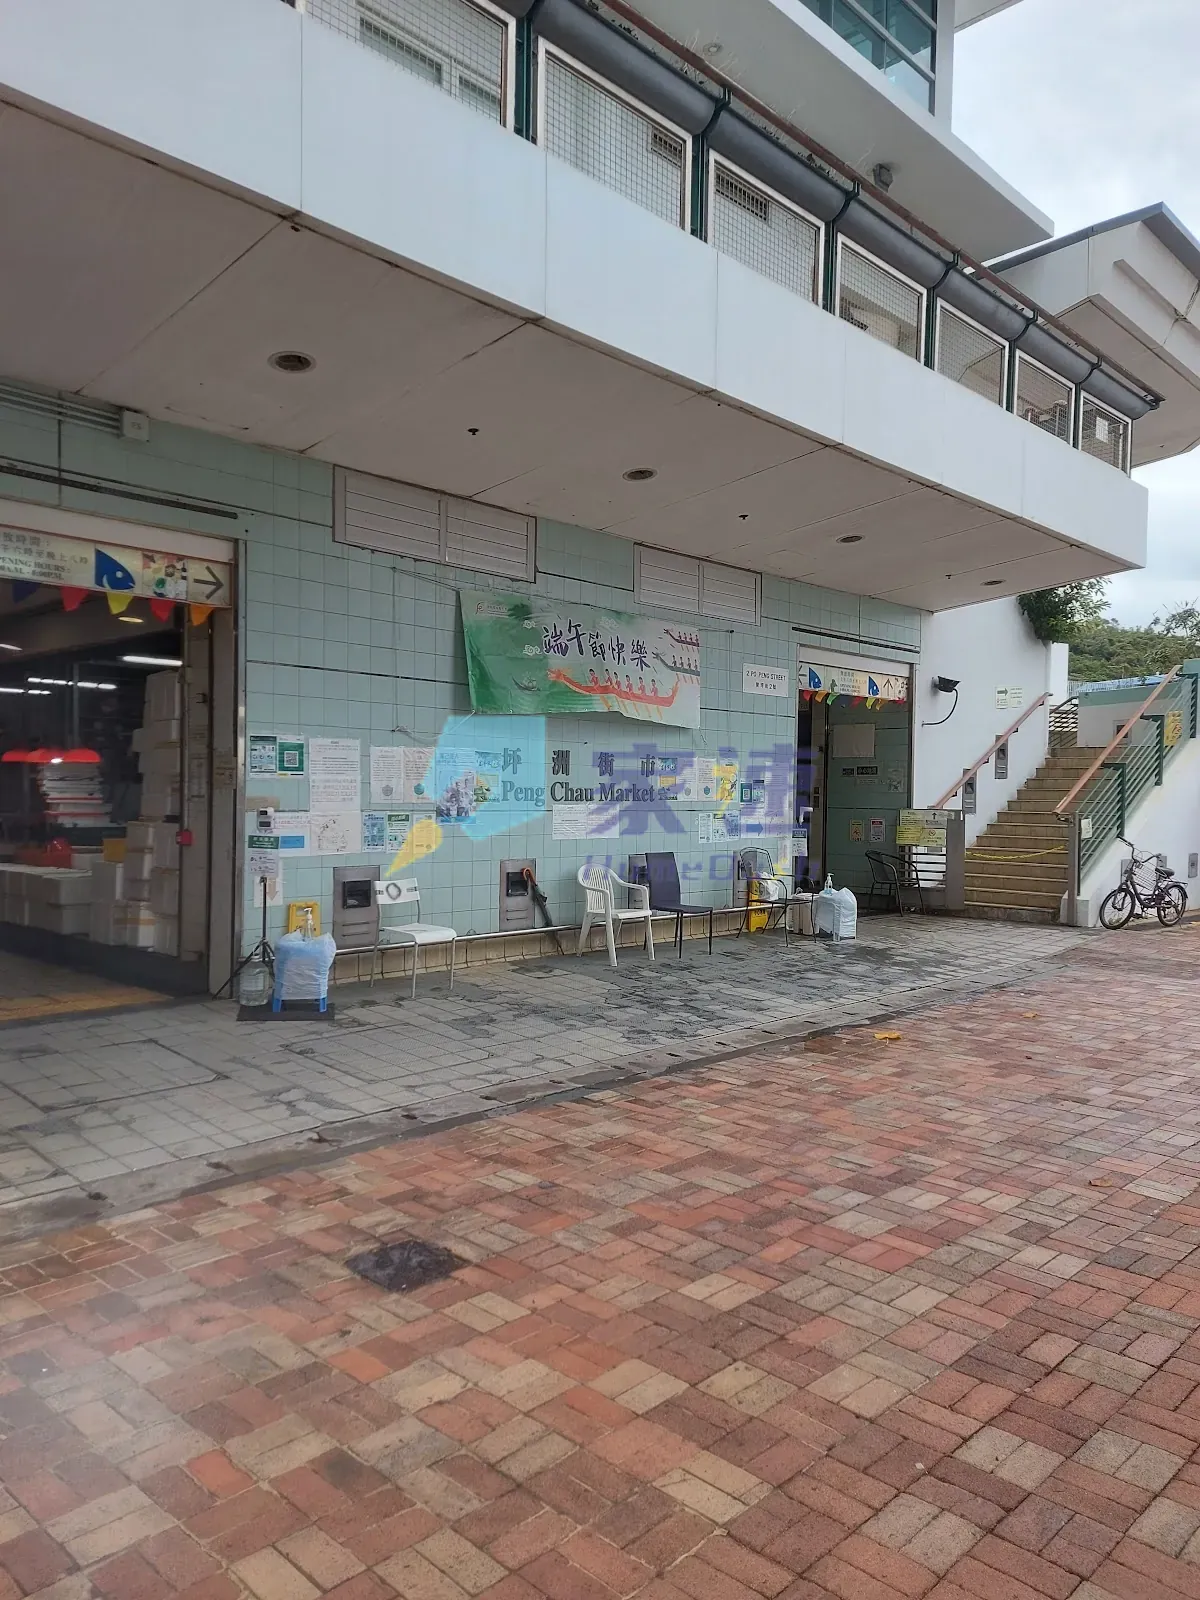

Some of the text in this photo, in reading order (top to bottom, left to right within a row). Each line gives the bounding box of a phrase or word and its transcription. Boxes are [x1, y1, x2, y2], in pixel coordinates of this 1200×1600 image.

[542, 618, 652, 672] 端午節快樂
[770, 673, 786, 681] STREET
[501, 780, 655, 807] Peng Chau Market
